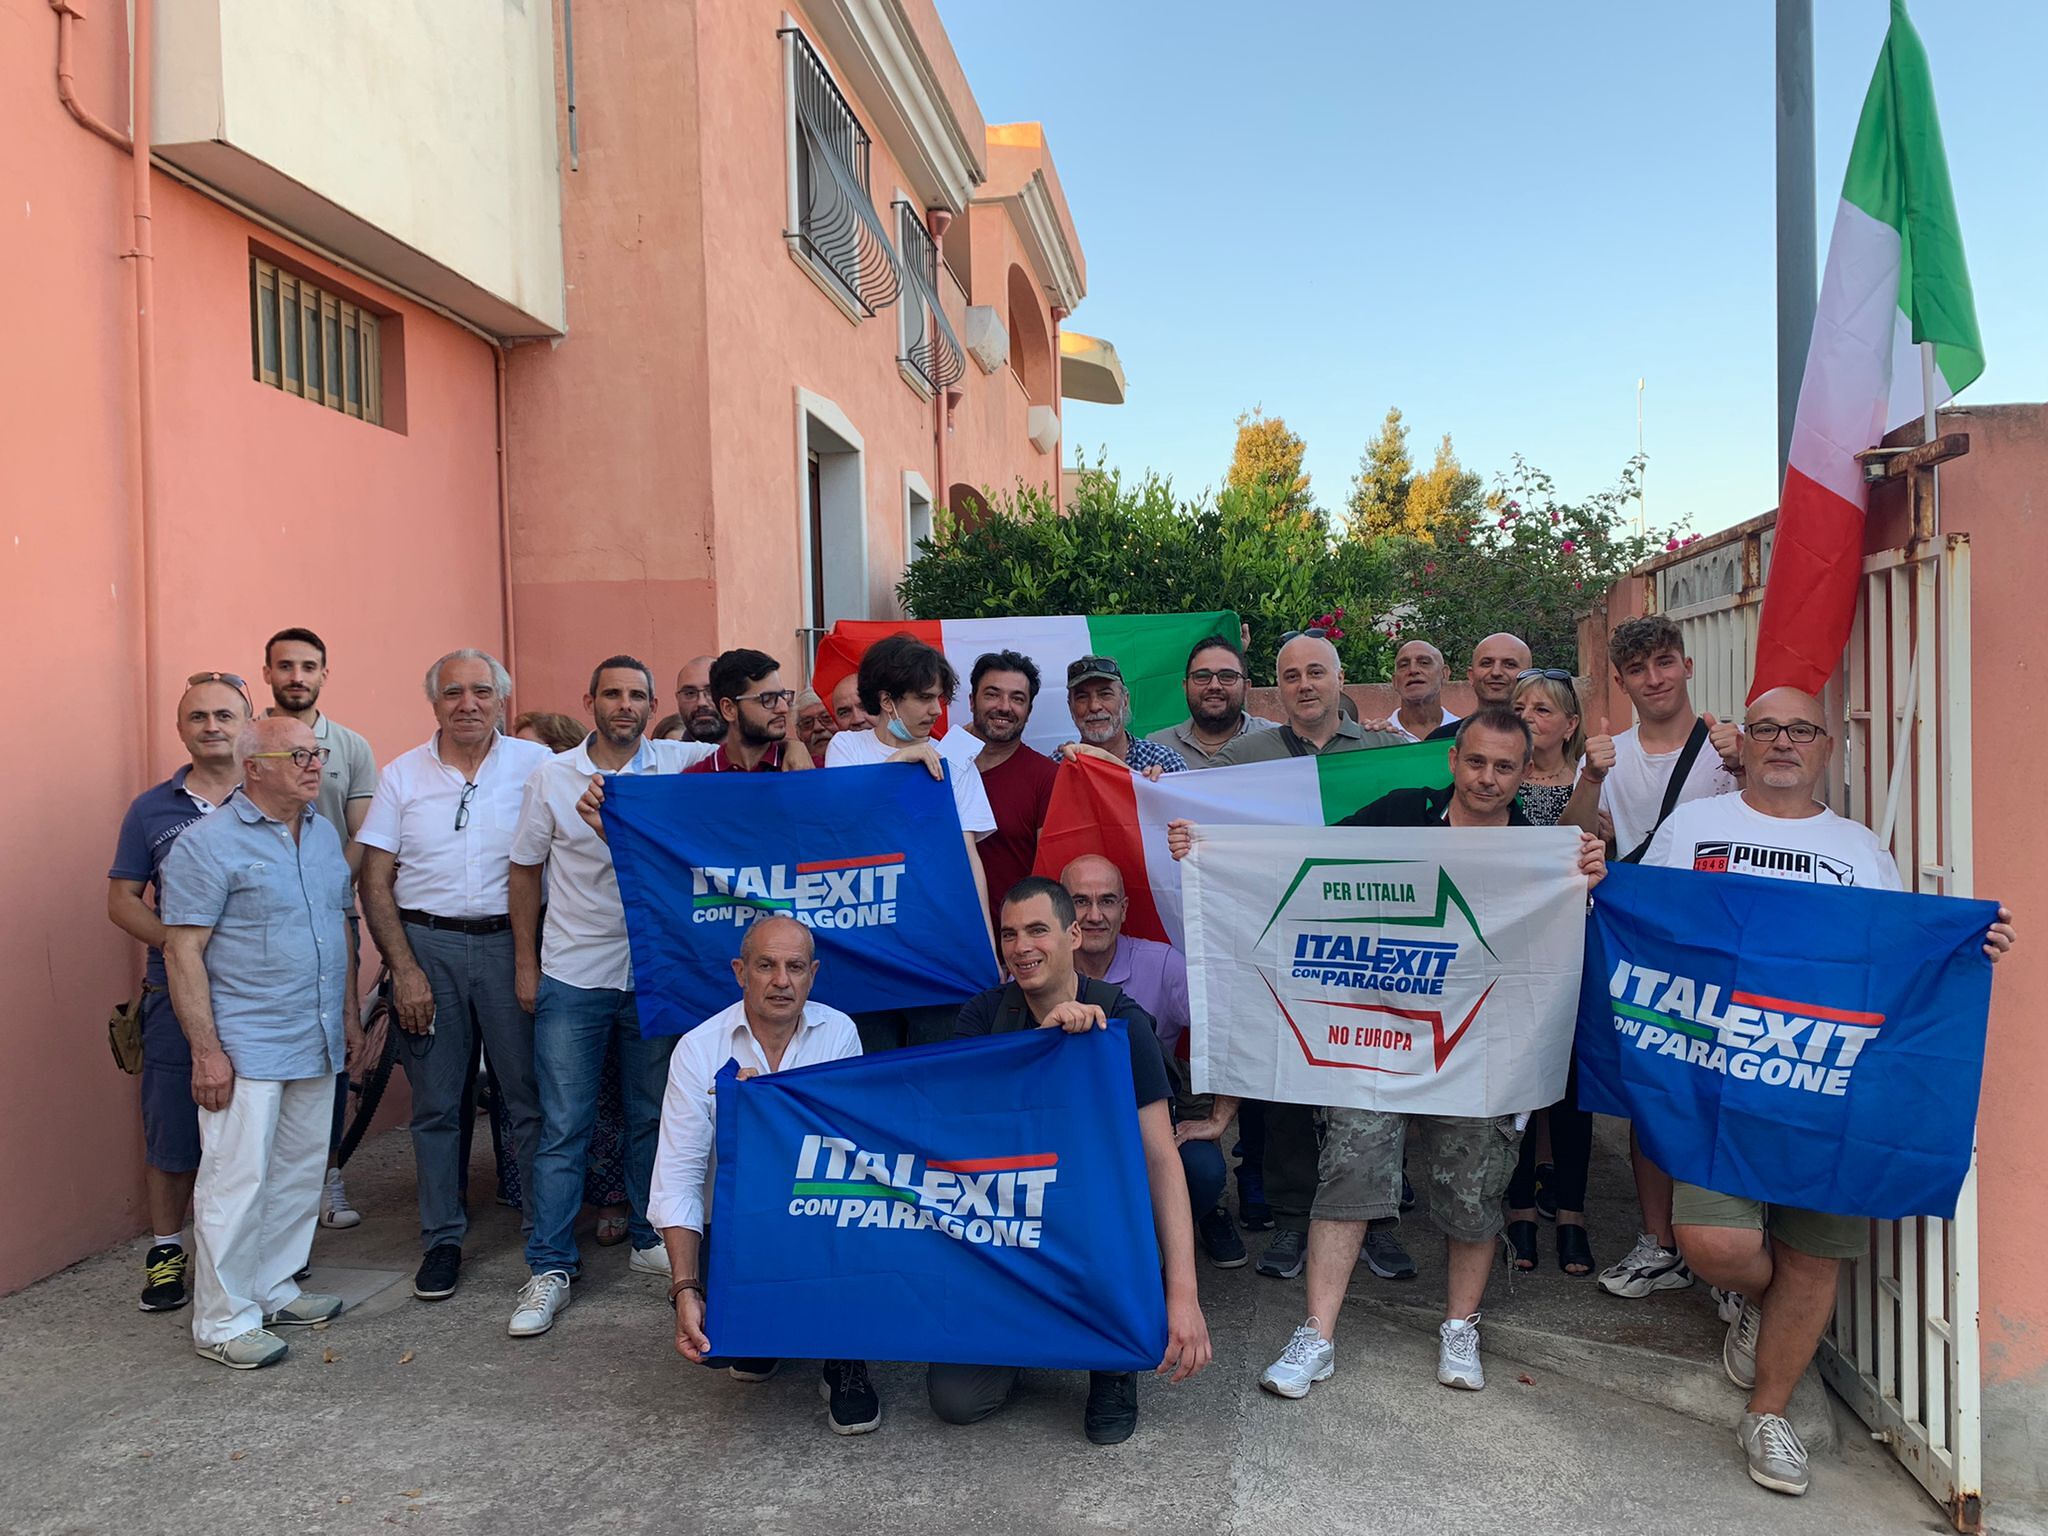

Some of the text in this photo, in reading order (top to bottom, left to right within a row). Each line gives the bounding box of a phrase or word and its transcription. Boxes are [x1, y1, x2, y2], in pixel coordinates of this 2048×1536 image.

[1696, 859, 1724, 871] 1948
[1732, 845, 1811, 873] PUMA
[690, 864, 905, 910] ITALEXIT
[1322, 881, 1416, 903] PER L'ITALIA
[692, 905, 733, 924] CON
[1293, 934, 1457, 978] ITALEXIT
[1291, 968, 1444, 995] CON PARAGONE
[1609, 959, 1880, 1067] ITALEXIT
[1328, 1025, 1412, 1051] NO EUROPA
[1613, 1015, 1852, 1096] ON PARAGONE
[795, 1134, 1057, 1217] ITALEXIT
[788, 1198, 1042, 1248] CON PARAGONE
